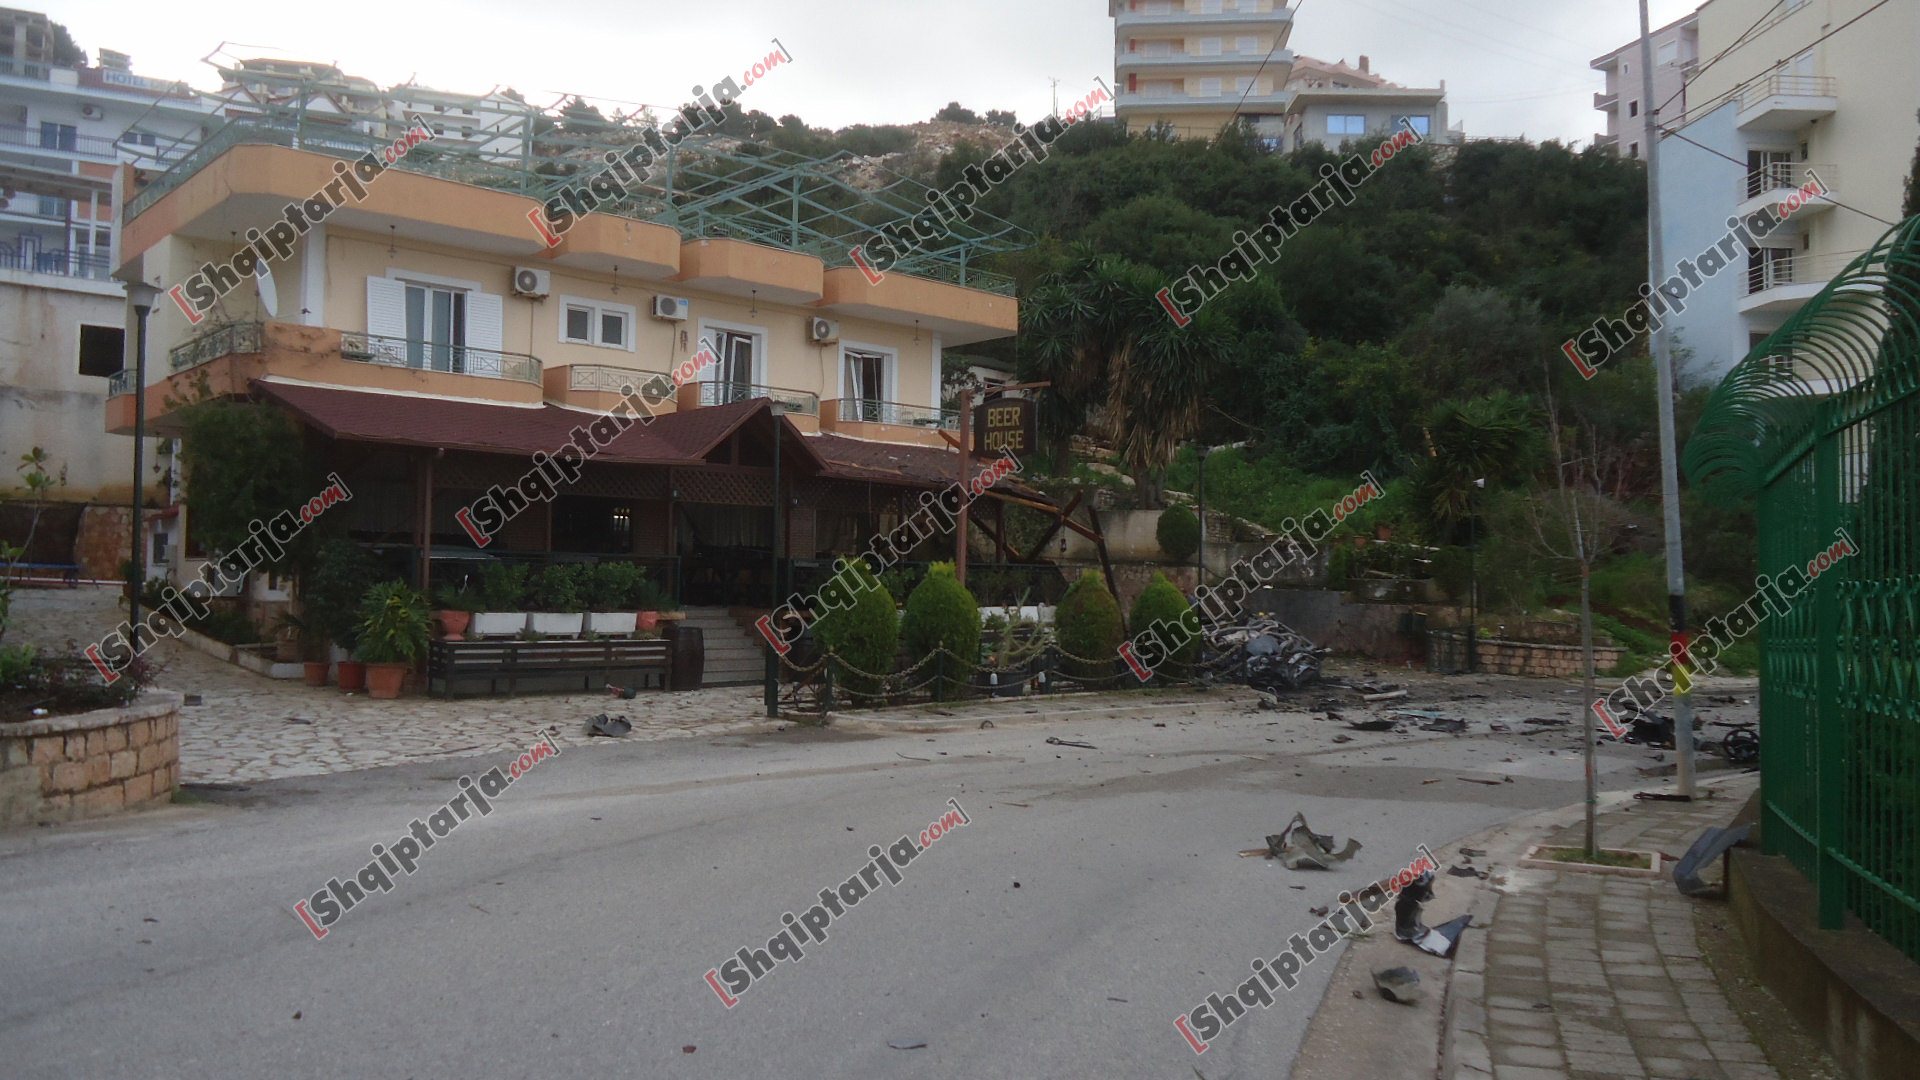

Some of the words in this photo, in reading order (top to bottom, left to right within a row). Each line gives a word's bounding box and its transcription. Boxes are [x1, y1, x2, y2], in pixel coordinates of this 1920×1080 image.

[105, 71, 145, 87] HOTEL
[987, 407, 1020, 427] BEER
[984, 430, 1024, 451] HOUSE
